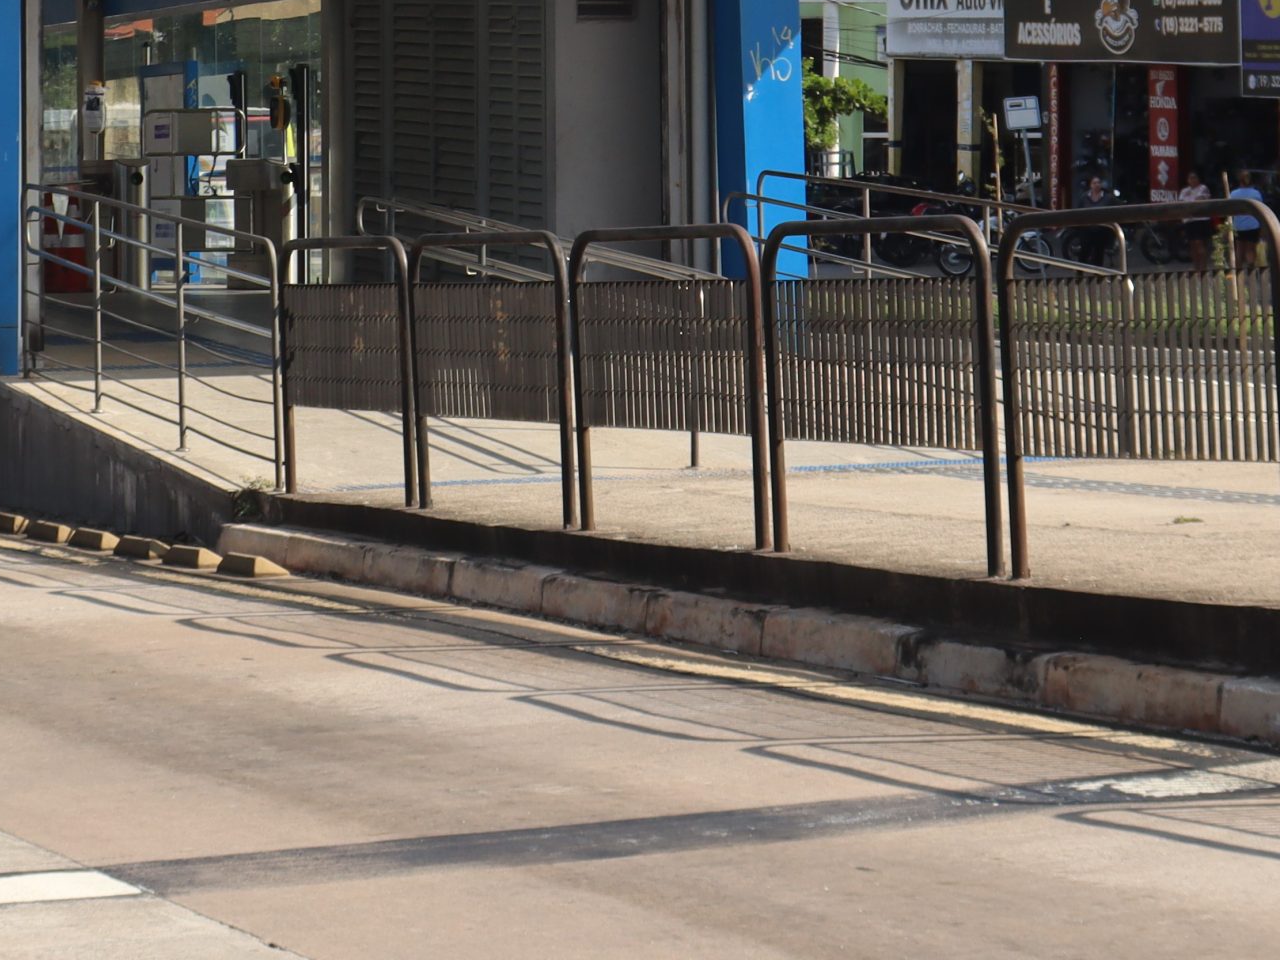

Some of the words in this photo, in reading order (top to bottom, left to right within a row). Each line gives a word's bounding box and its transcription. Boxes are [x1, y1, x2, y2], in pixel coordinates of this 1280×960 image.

[1017, 17, 1082, 46] ACESSÓRIOS
[1162, 16, 1178, 36] (19)
[1179, 16, 1224, 33] 3221-5775
[1149, 96, 1178, 109] HONDA
[1150, 144, 1179, 158] YAMAHA
[1149, 188, 1179, 203] SUZUKI
